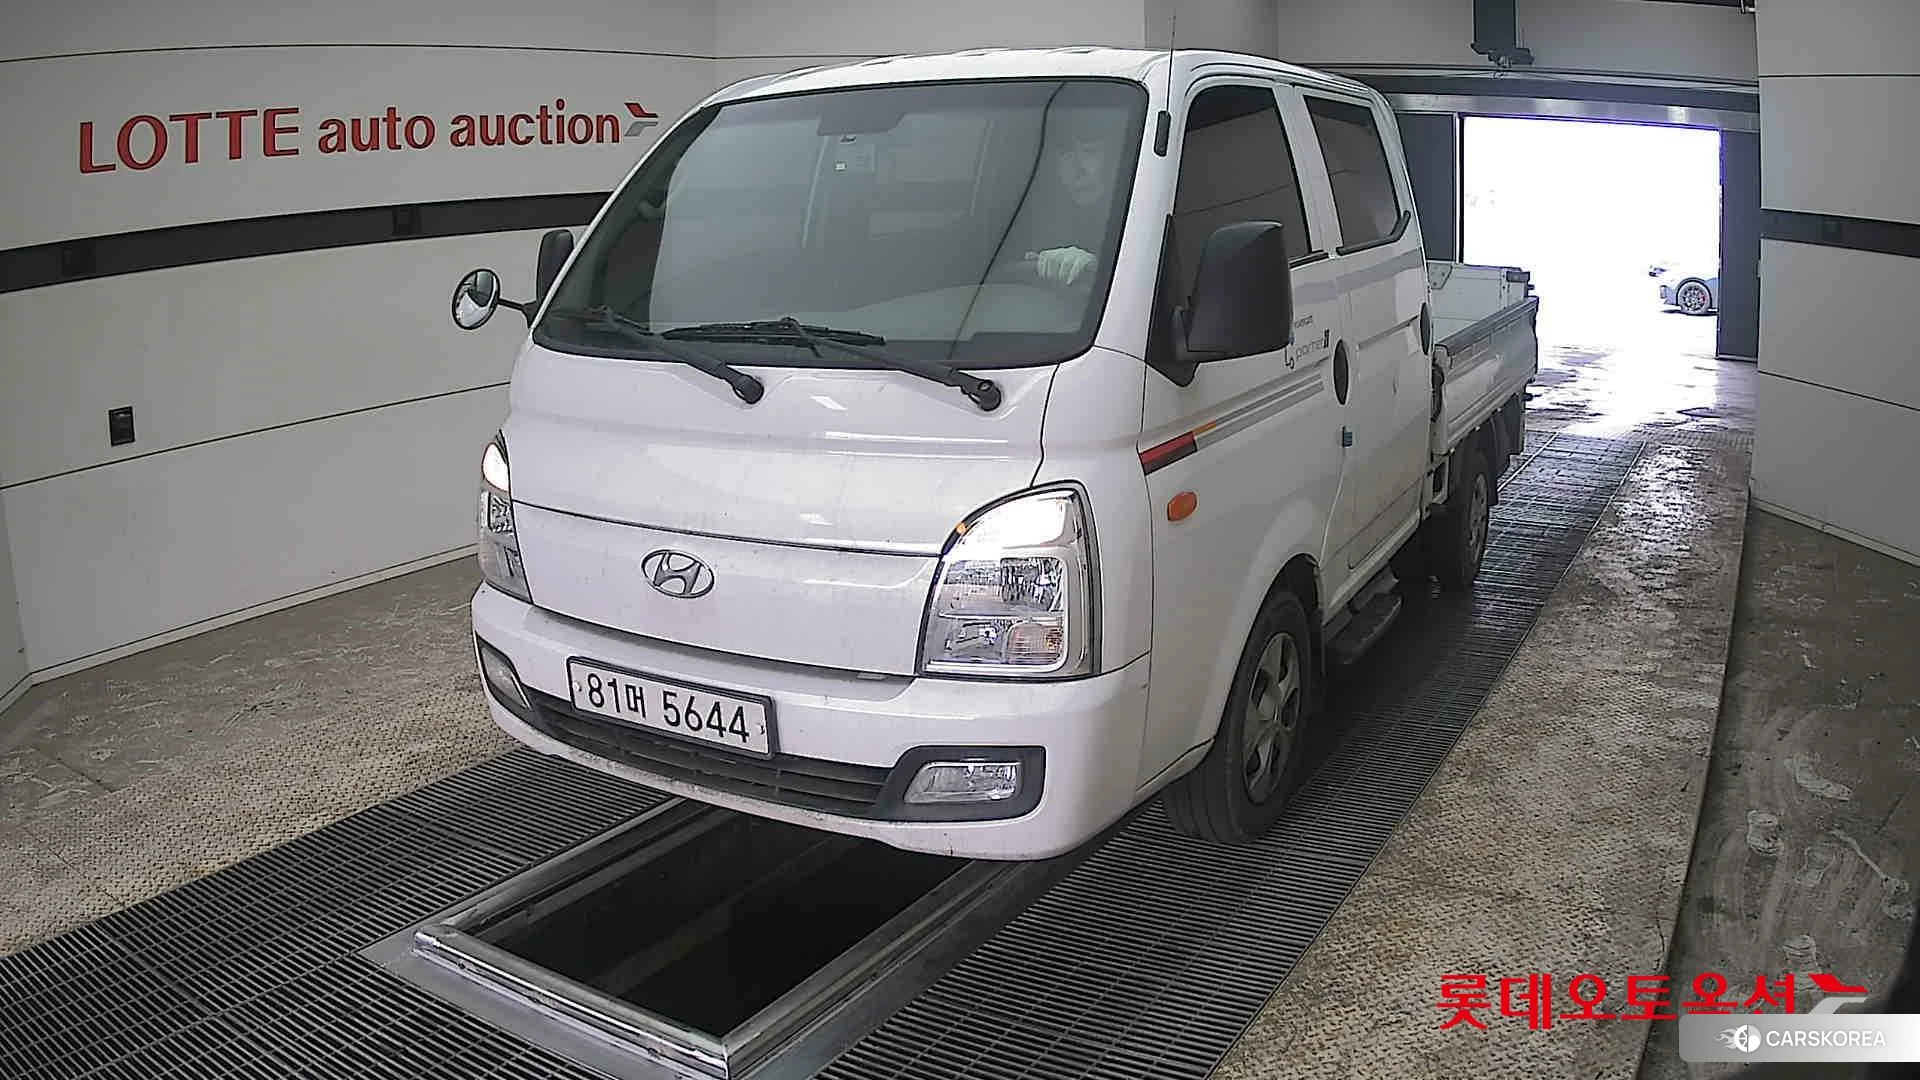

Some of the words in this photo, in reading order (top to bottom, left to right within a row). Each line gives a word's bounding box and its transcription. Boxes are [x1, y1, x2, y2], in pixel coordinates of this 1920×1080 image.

[79, 107, 299, 174] LOTTE
[317, 107, 436, 153] auto
[450, 99, 621, 147] auction
[587, 672, 647, 720] 81머
[662, 690, 750, 744] 5644
